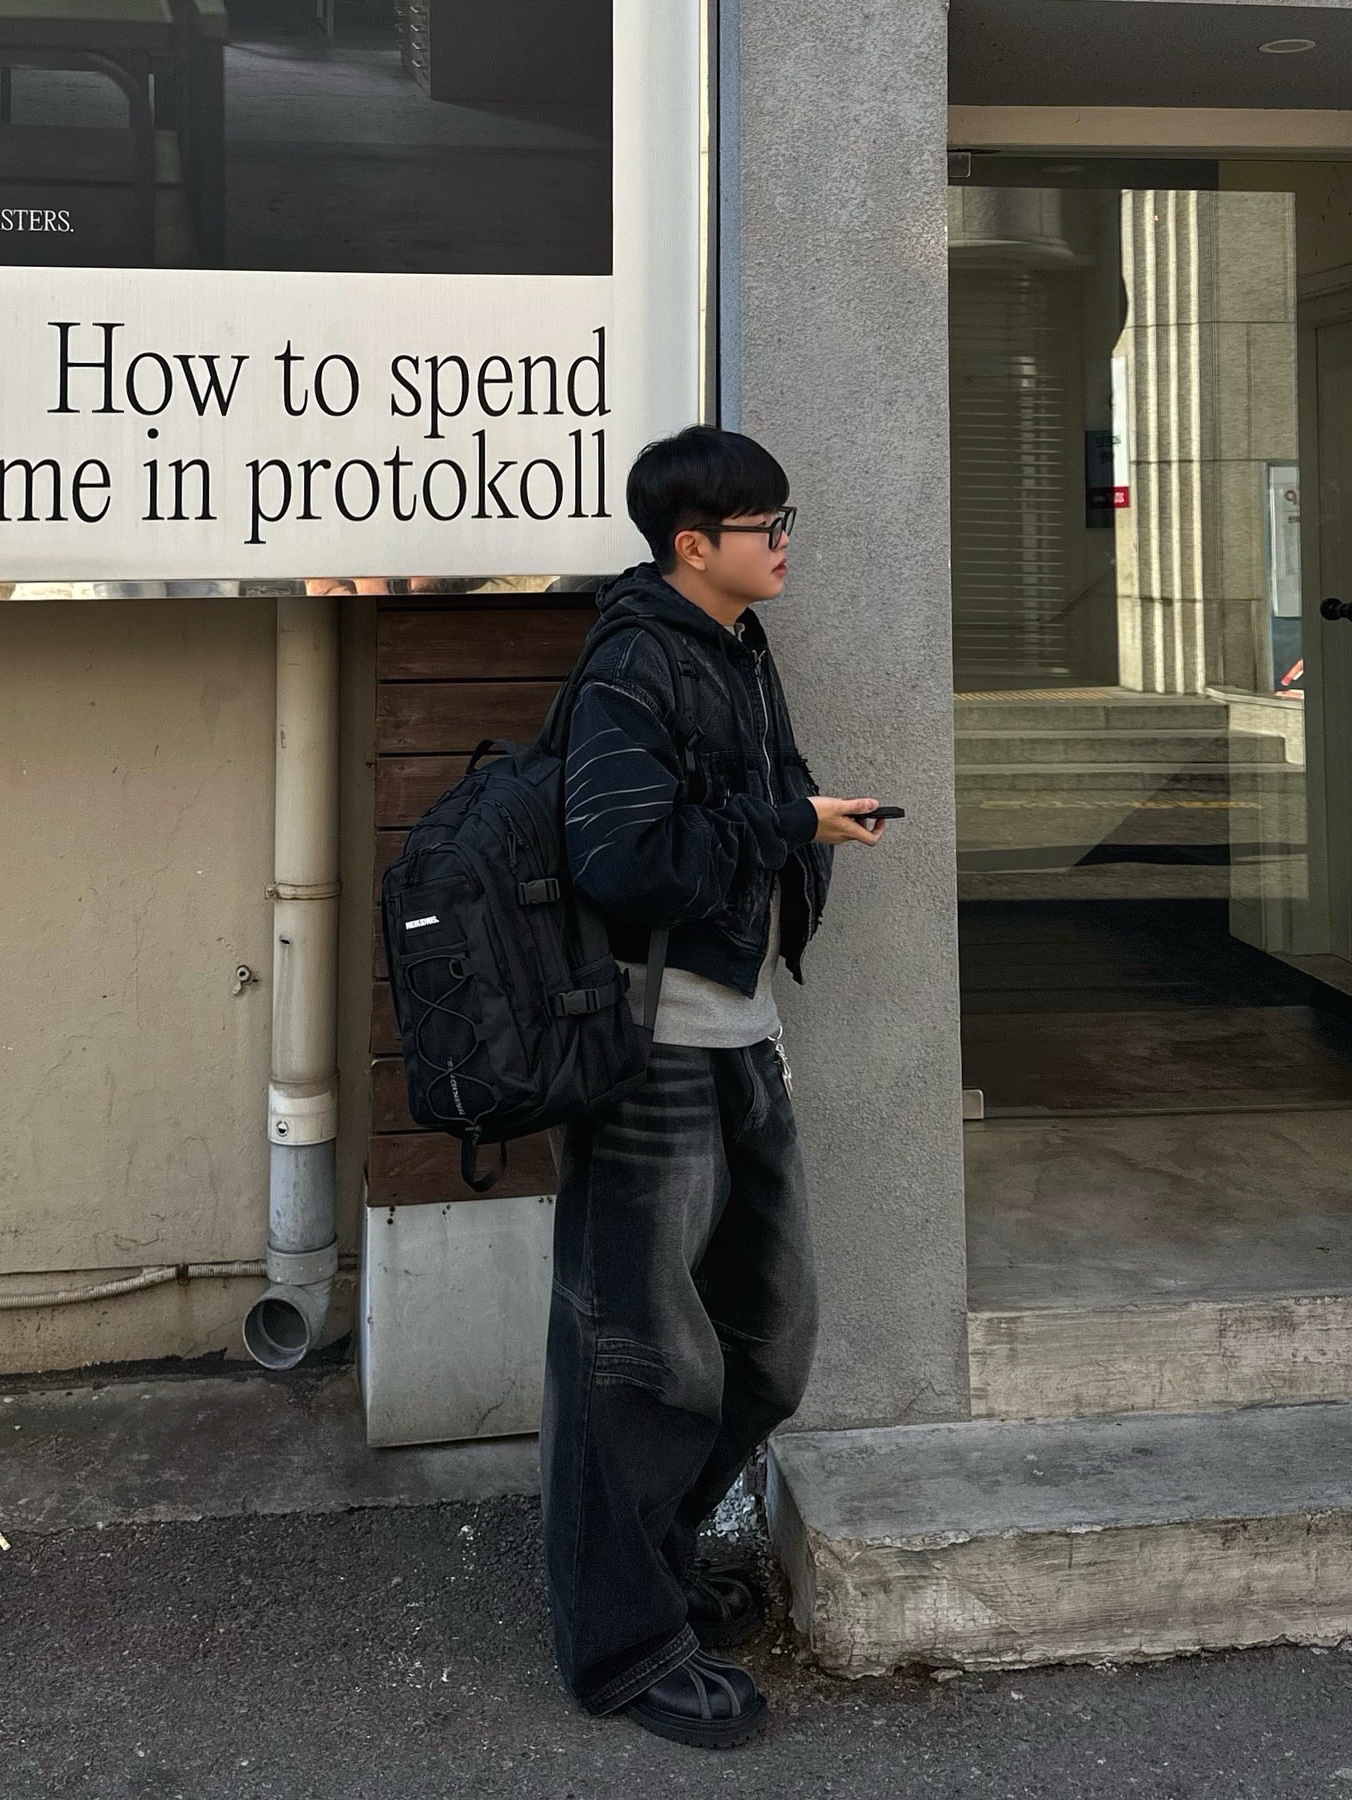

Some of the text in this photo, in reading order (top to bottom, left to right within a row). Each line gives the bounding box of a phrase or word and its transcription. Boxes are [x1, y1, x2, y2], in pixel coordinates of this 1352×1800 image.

[1, 208, 75, 233] STERS.
[46, 321, 612, 440] How to spend
[0, 427, 612, 545] me in protokoll
